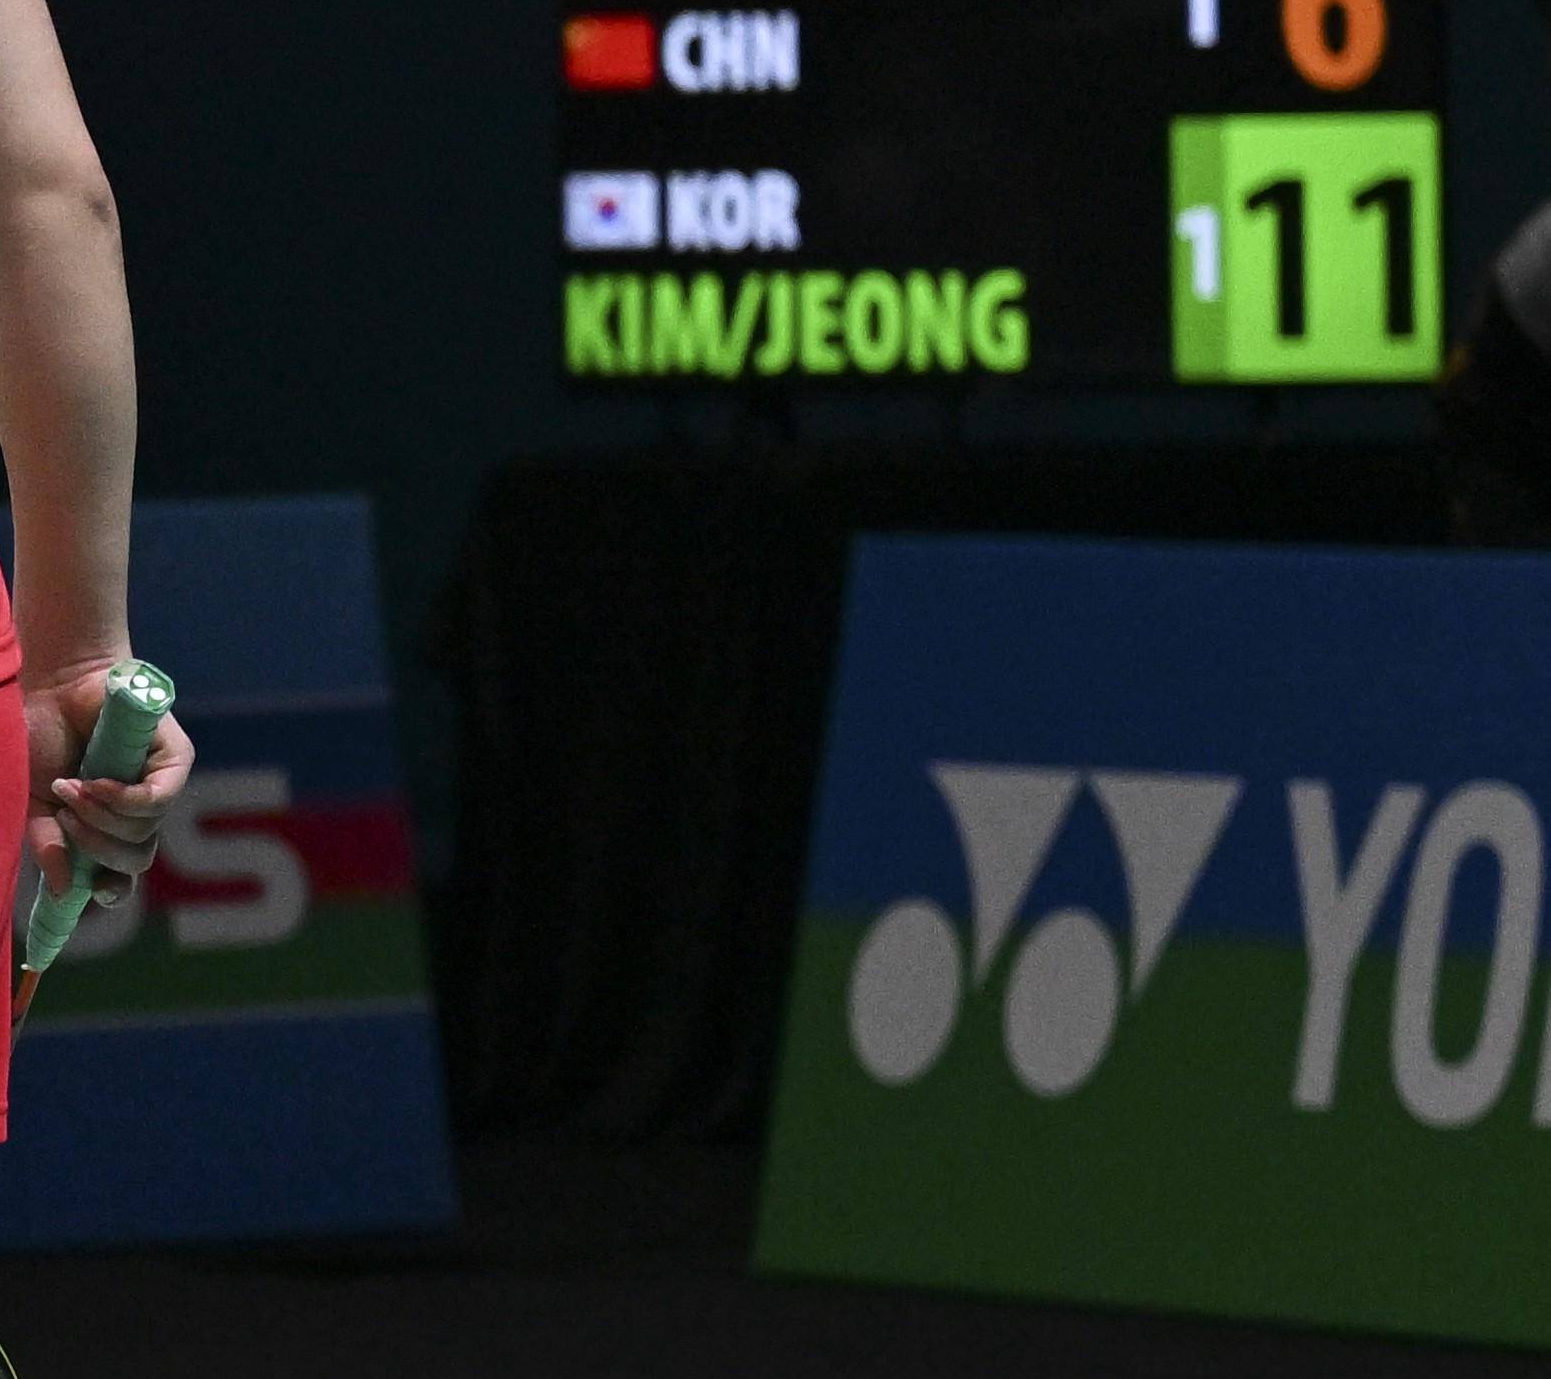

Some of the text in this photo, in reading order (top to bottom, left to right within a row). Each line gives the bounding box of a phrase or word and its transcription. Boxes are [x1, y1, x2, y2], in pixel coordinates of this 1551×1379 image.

[660, 11, 801, 92] CHN
[665, 170, 801, 252] KOR
[1177, 174, 1416, 345] 1 11
[563, 268, 1031, 379] KIM/JEONG
[1284, 776, 1551, 1131] YO
